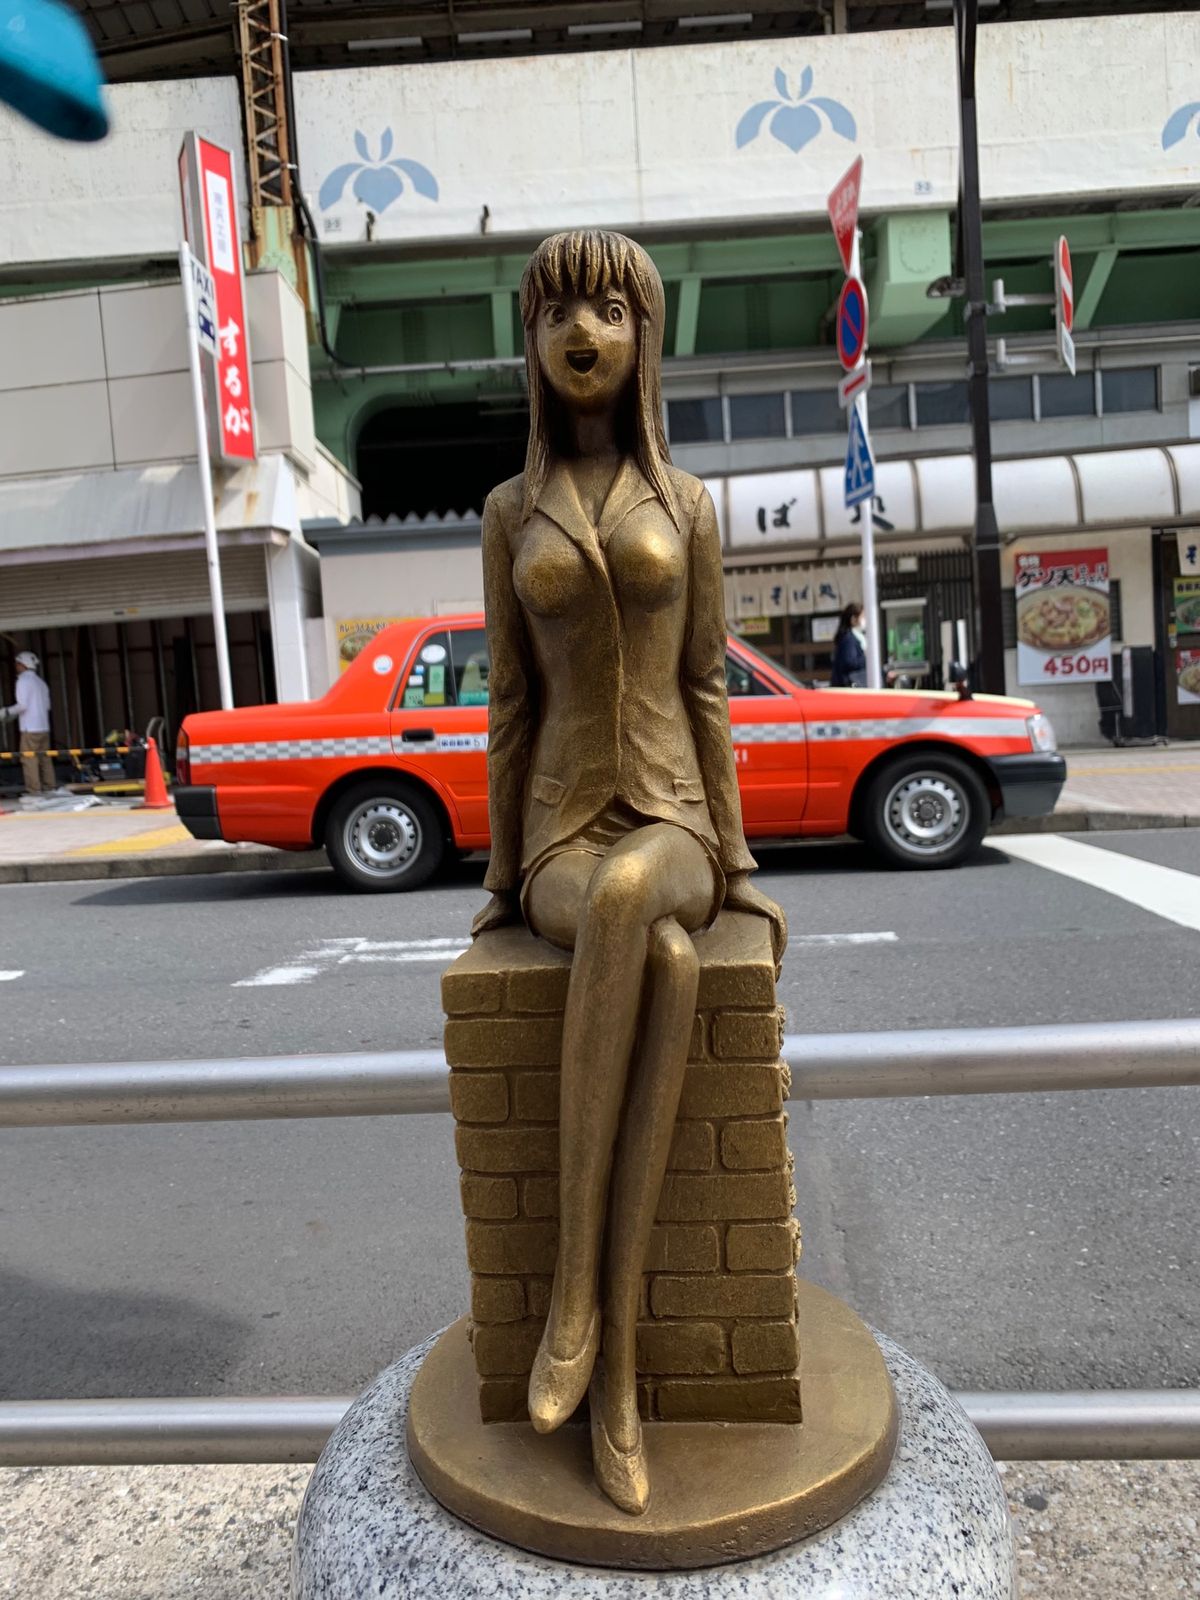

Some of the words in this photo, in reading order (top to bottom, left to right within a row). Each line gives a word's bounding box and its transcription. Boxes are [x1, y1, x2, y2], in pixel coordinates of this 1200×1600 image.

[191, 259, 215, 301] TAXI
[219, 319, 250, 435] するが
[770, 584, 837, 605] そば処
[1044, 656, 1108, 675] 450円
